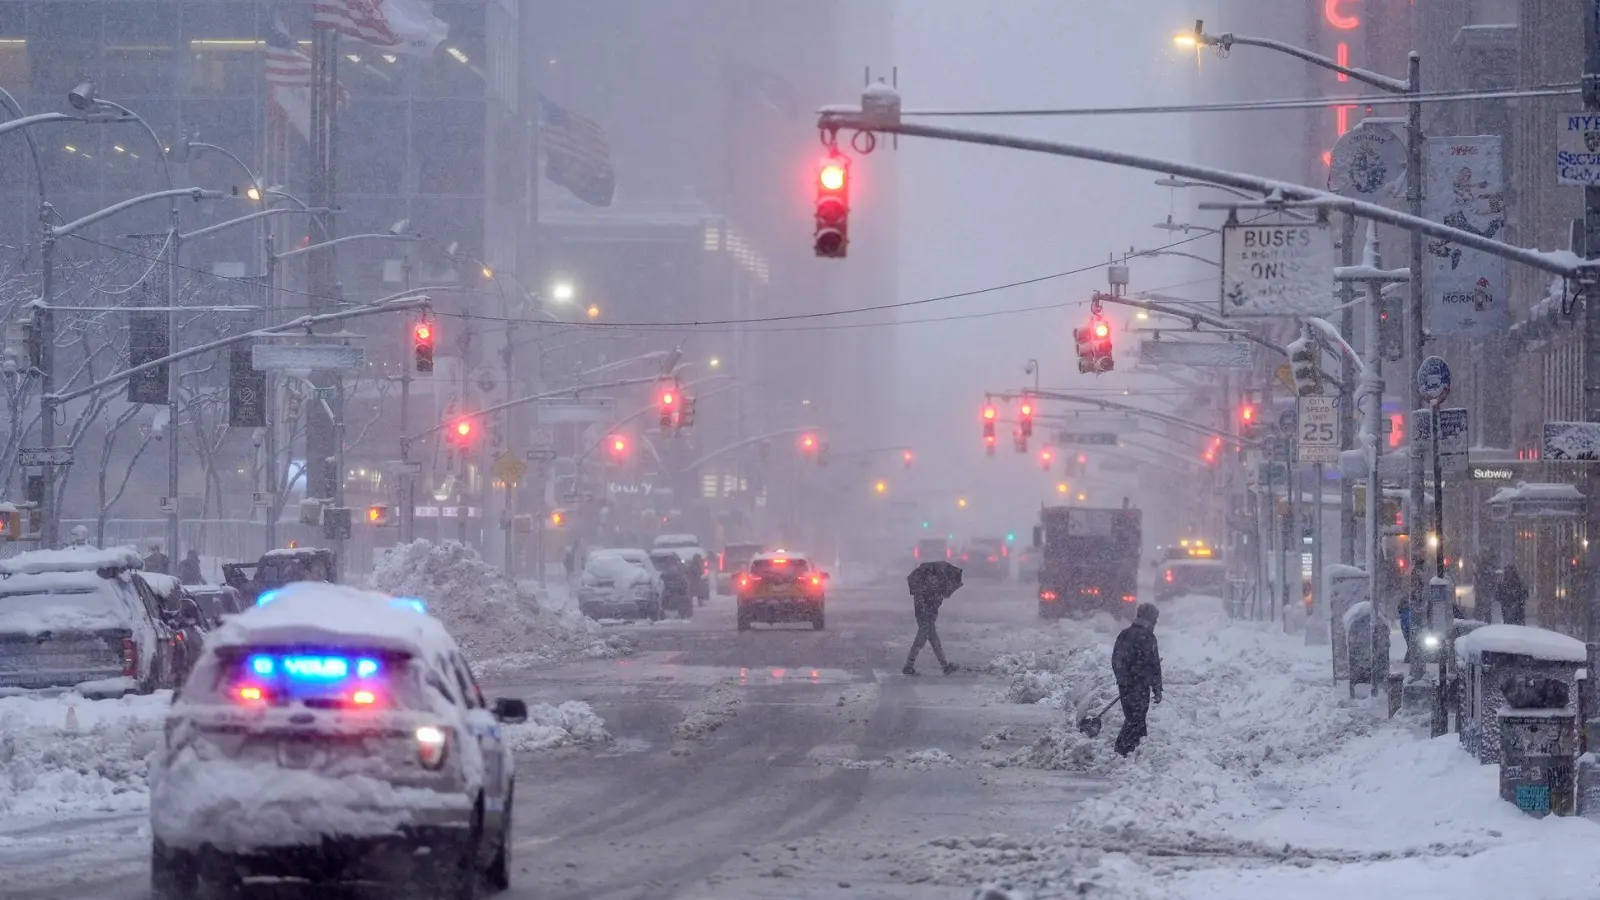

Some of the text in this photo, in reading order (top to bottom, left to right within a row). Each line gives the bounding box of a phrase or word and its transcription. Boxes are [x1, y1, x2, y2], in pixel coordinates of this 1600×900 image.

[1244, 229, 1311, 248] BUSES
[1251, 262, 1288, 280] ONL
[1442, 294, 1493, 304] MORMN
[1303, 423, 1333, 441] 25
[1474, 468, 1513, 479] Subway
